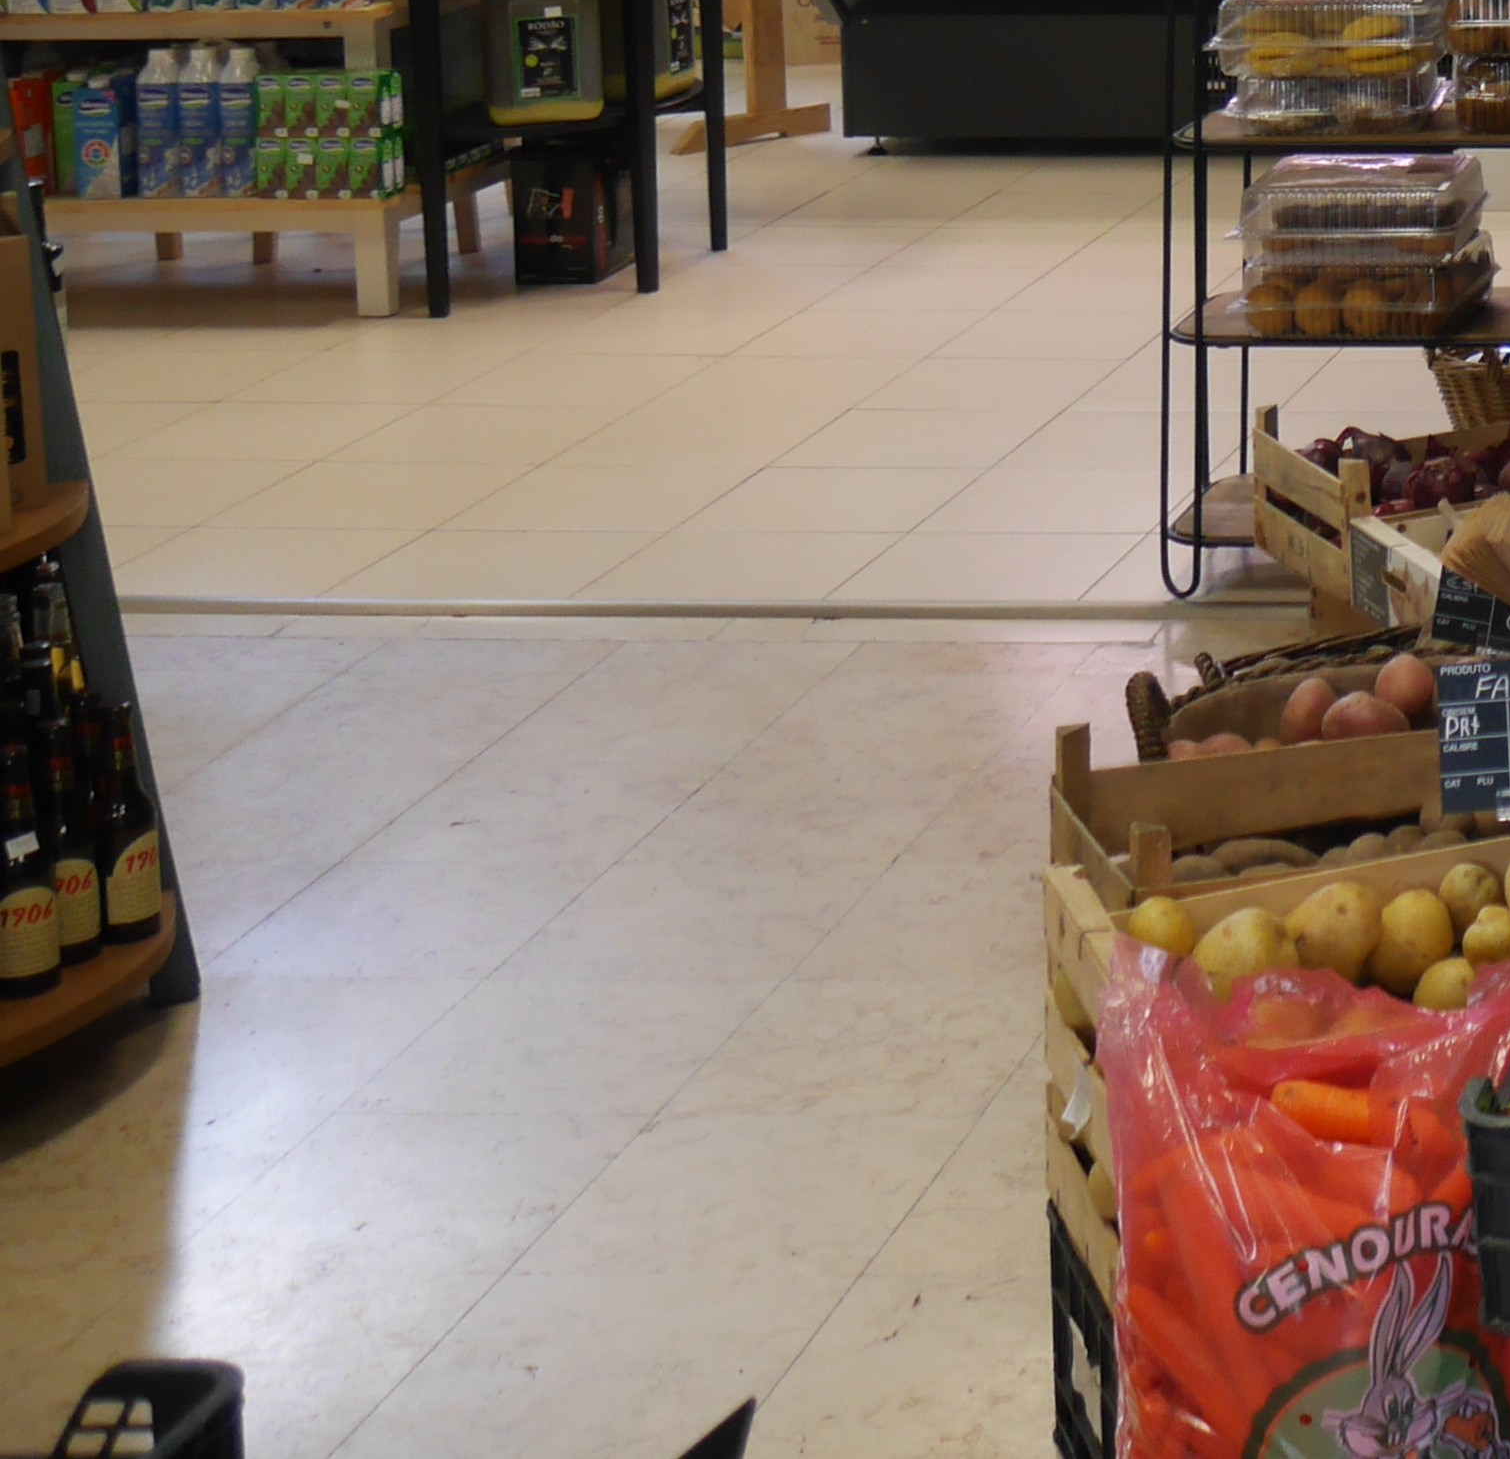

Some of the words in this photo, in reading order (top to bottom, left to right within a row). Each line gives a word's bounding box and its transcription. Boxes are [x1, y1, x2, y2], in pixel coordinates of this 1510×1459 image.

[1439, 663, 1492, 677] PRODUTO
[1444, 779, 1461, 790] CAT
[1476, 776, 1494, 786] PLU
[0, 896, 55, 929] 1906
[1235, 1202, 1478, 1334] CENOURA
